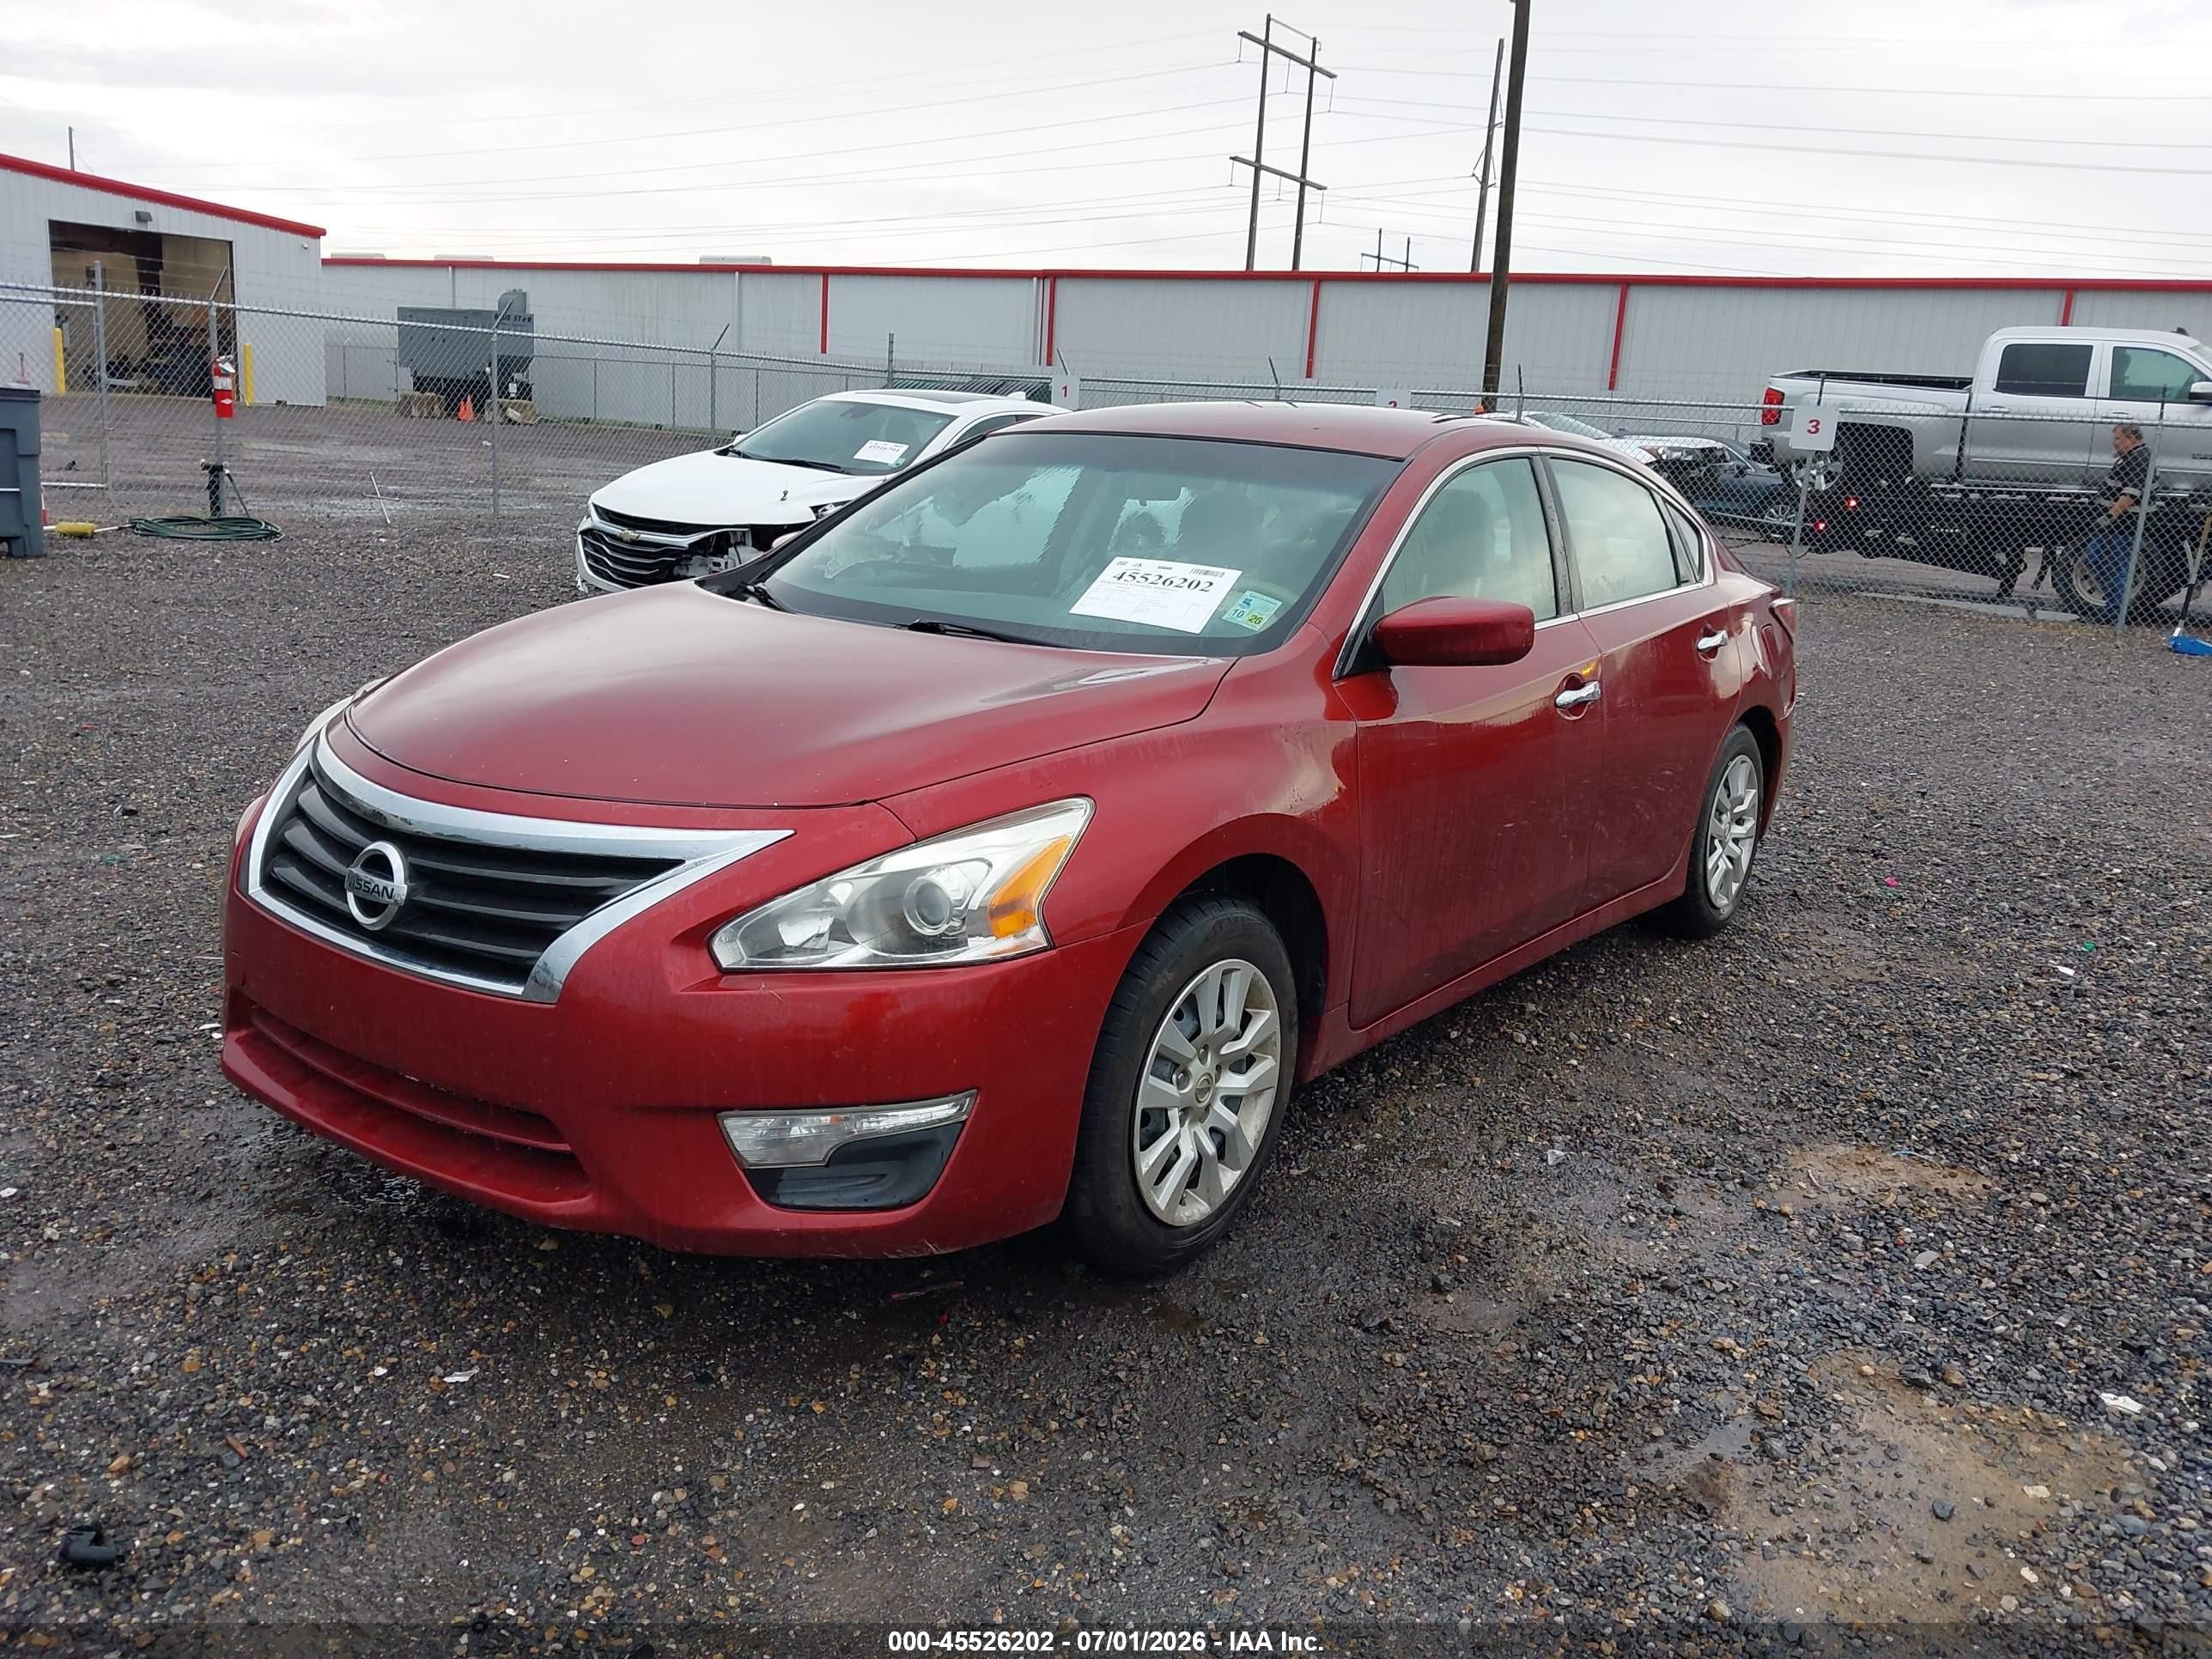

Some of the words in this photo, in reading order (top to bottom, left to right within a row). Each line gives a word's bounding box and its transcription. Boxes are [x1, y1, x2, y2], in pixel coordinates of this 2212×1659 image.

[1061, 385, 1068, 398] 1
[1807, 419, 1820, 434] 3
[1112, 570, 1214, 592] 45526202
[1231, 608, 1245, 618] 10
[1248, 614, 1263, 625] 26
[346, 870, 395, 900] NISSAN
